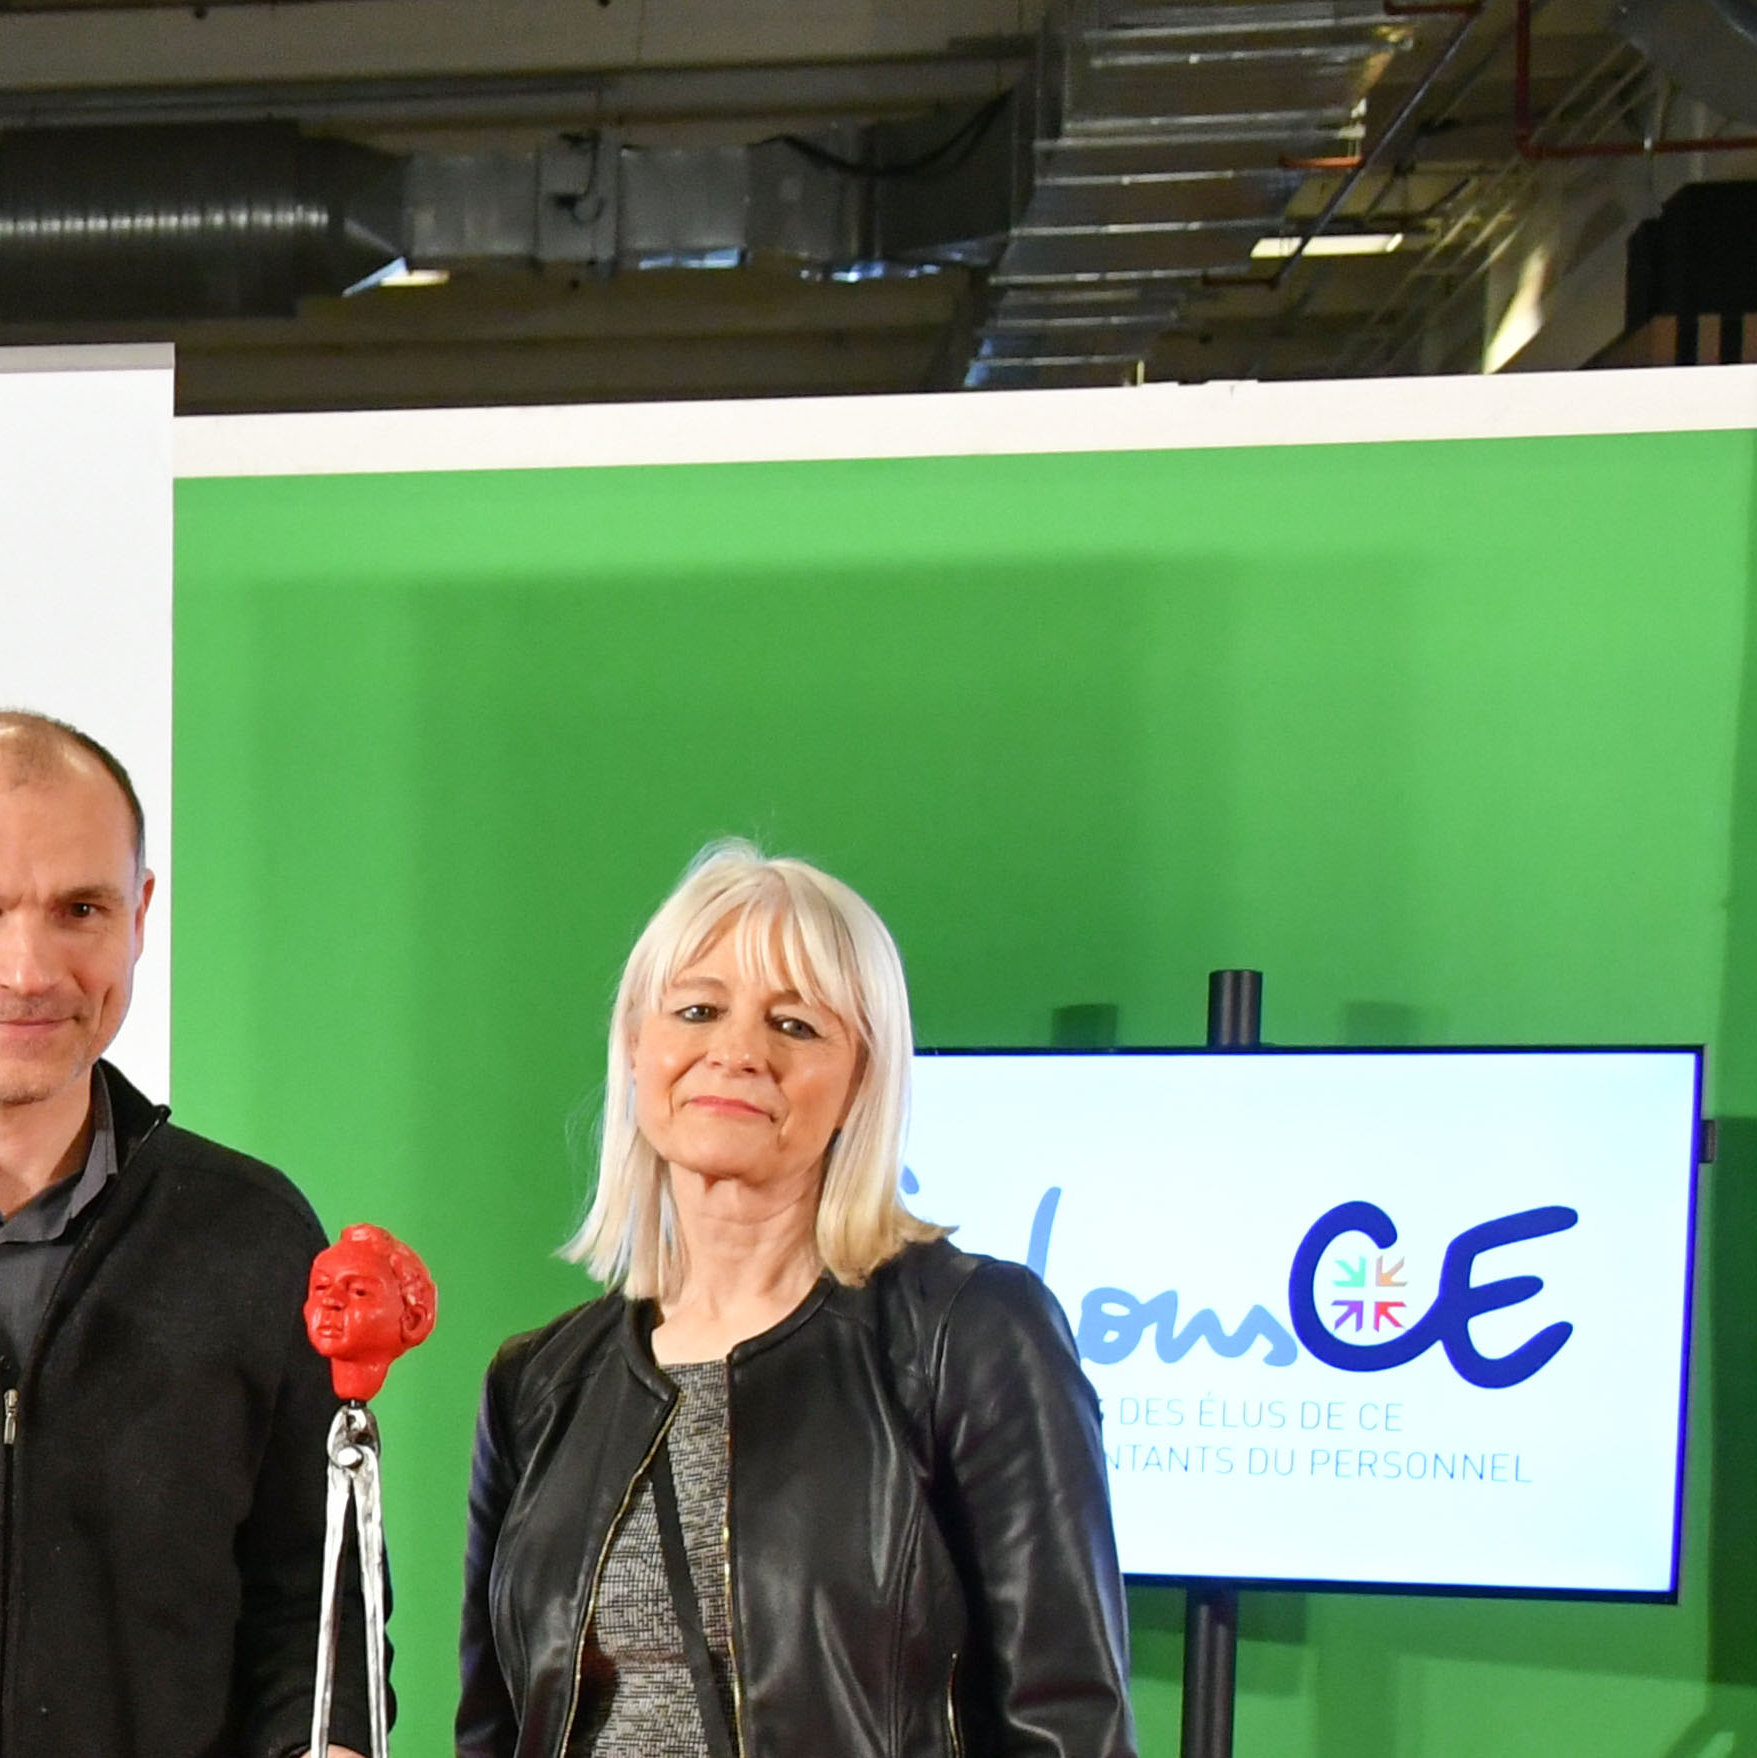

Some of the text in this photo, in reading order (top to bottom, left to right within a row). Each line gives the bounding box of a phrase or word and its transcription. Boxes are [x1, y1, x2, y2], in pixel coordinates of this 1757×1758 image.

[1119, 1397, 1185, 1427] DES
[1199, 1391, 1286, 1429] ÉLUS
[1300, 1401, 1346, 1431] DE
[1358, 1403, 1404, 1432] CE
[1248, 1446, 1295, 1477] DU
[1310, 1447, 1534, 1483] PERSONNEL
